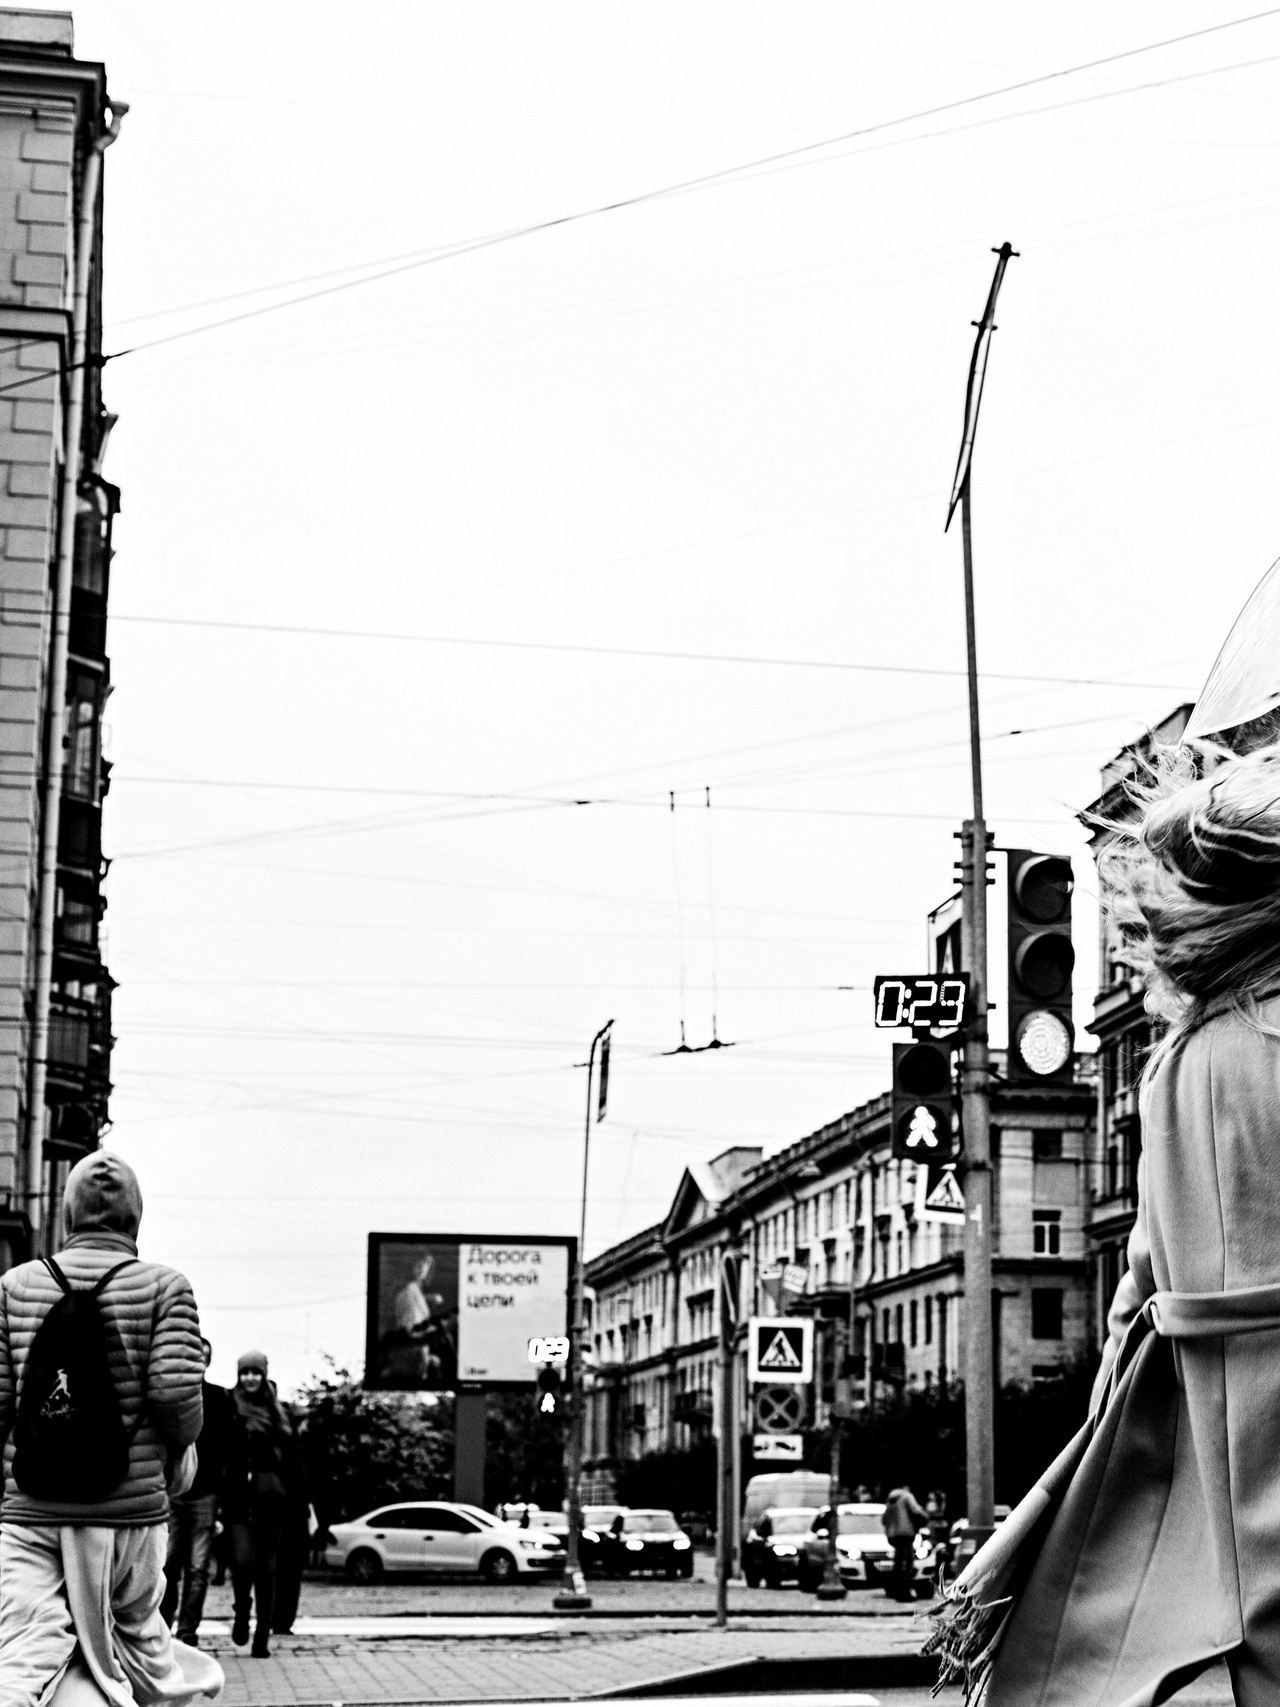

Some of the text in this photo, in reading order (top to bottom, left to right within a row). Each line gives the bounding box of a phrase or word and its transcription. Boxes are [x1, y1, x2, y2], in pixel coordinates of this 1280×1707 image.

[876, 981, 966, 1027] 0:29
[468, 1246, 541, 1267] Дорога
[467, 1270, 538, 1286] к твоей
[467, 1295, 514, 1308] цели
